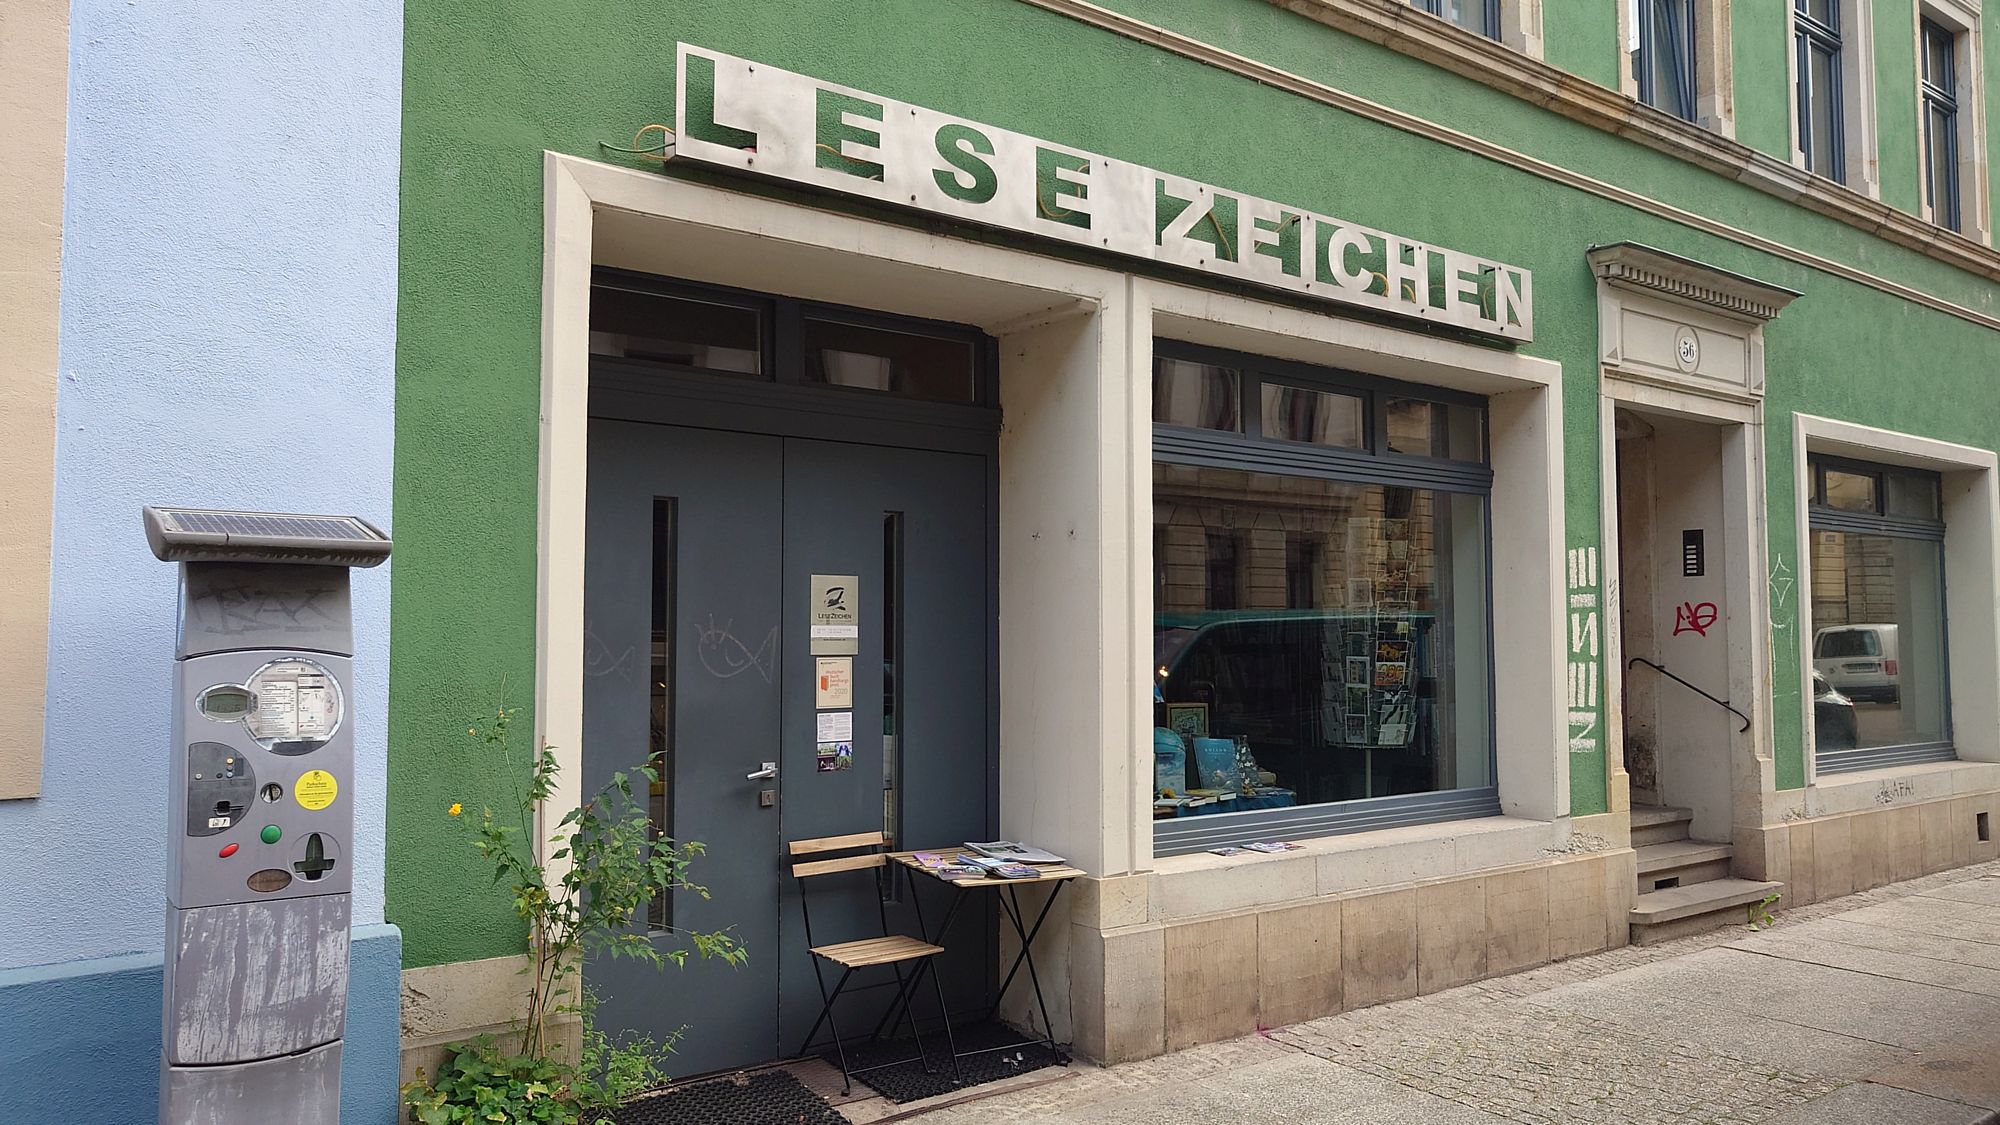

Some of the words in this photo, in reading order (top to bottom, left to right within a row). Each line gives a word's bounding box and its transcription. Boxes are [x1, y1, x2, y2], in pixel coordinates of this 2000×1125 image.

[685, 52, 1092, 230] LESE
[1160, 180, 1531, 334] ZEICHEN
[1682, 340, 1695, 359] 56
